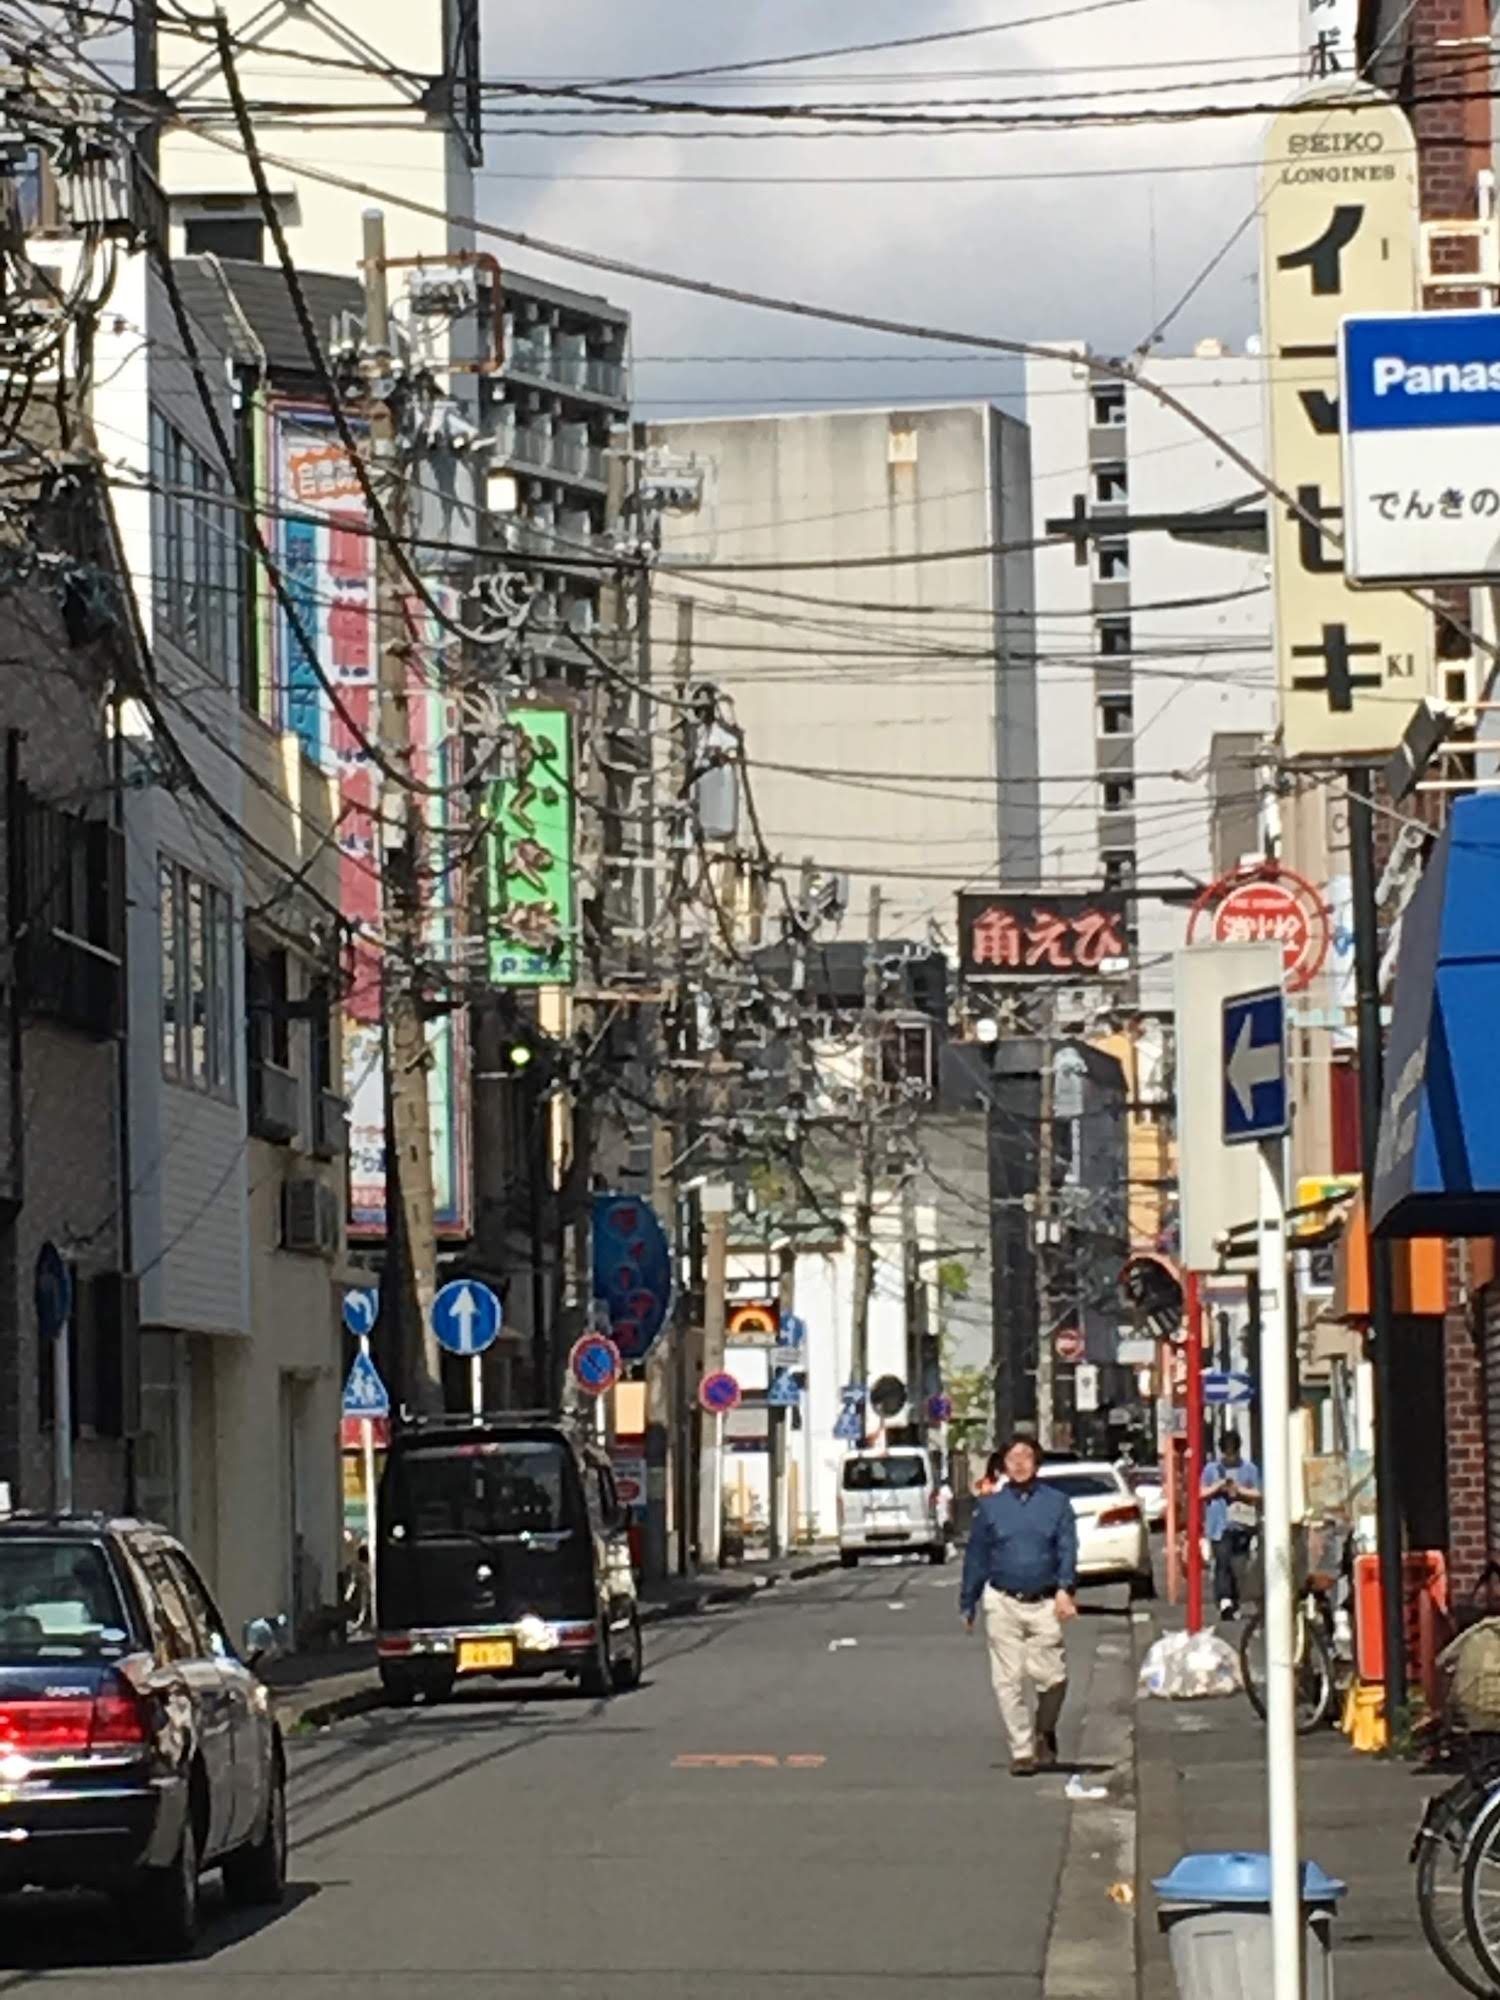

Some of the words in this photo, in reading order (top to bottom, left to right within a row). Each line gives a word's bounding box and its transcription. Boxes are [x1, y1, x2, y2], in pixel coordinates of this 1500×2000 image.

[1287, 131, 1384, 154] SEIKO
[1279, 163, 1397, 186] LONGINES
[1368, 486, 1500, 521] でんきの
[1386, 652, 1415, 678] KI
